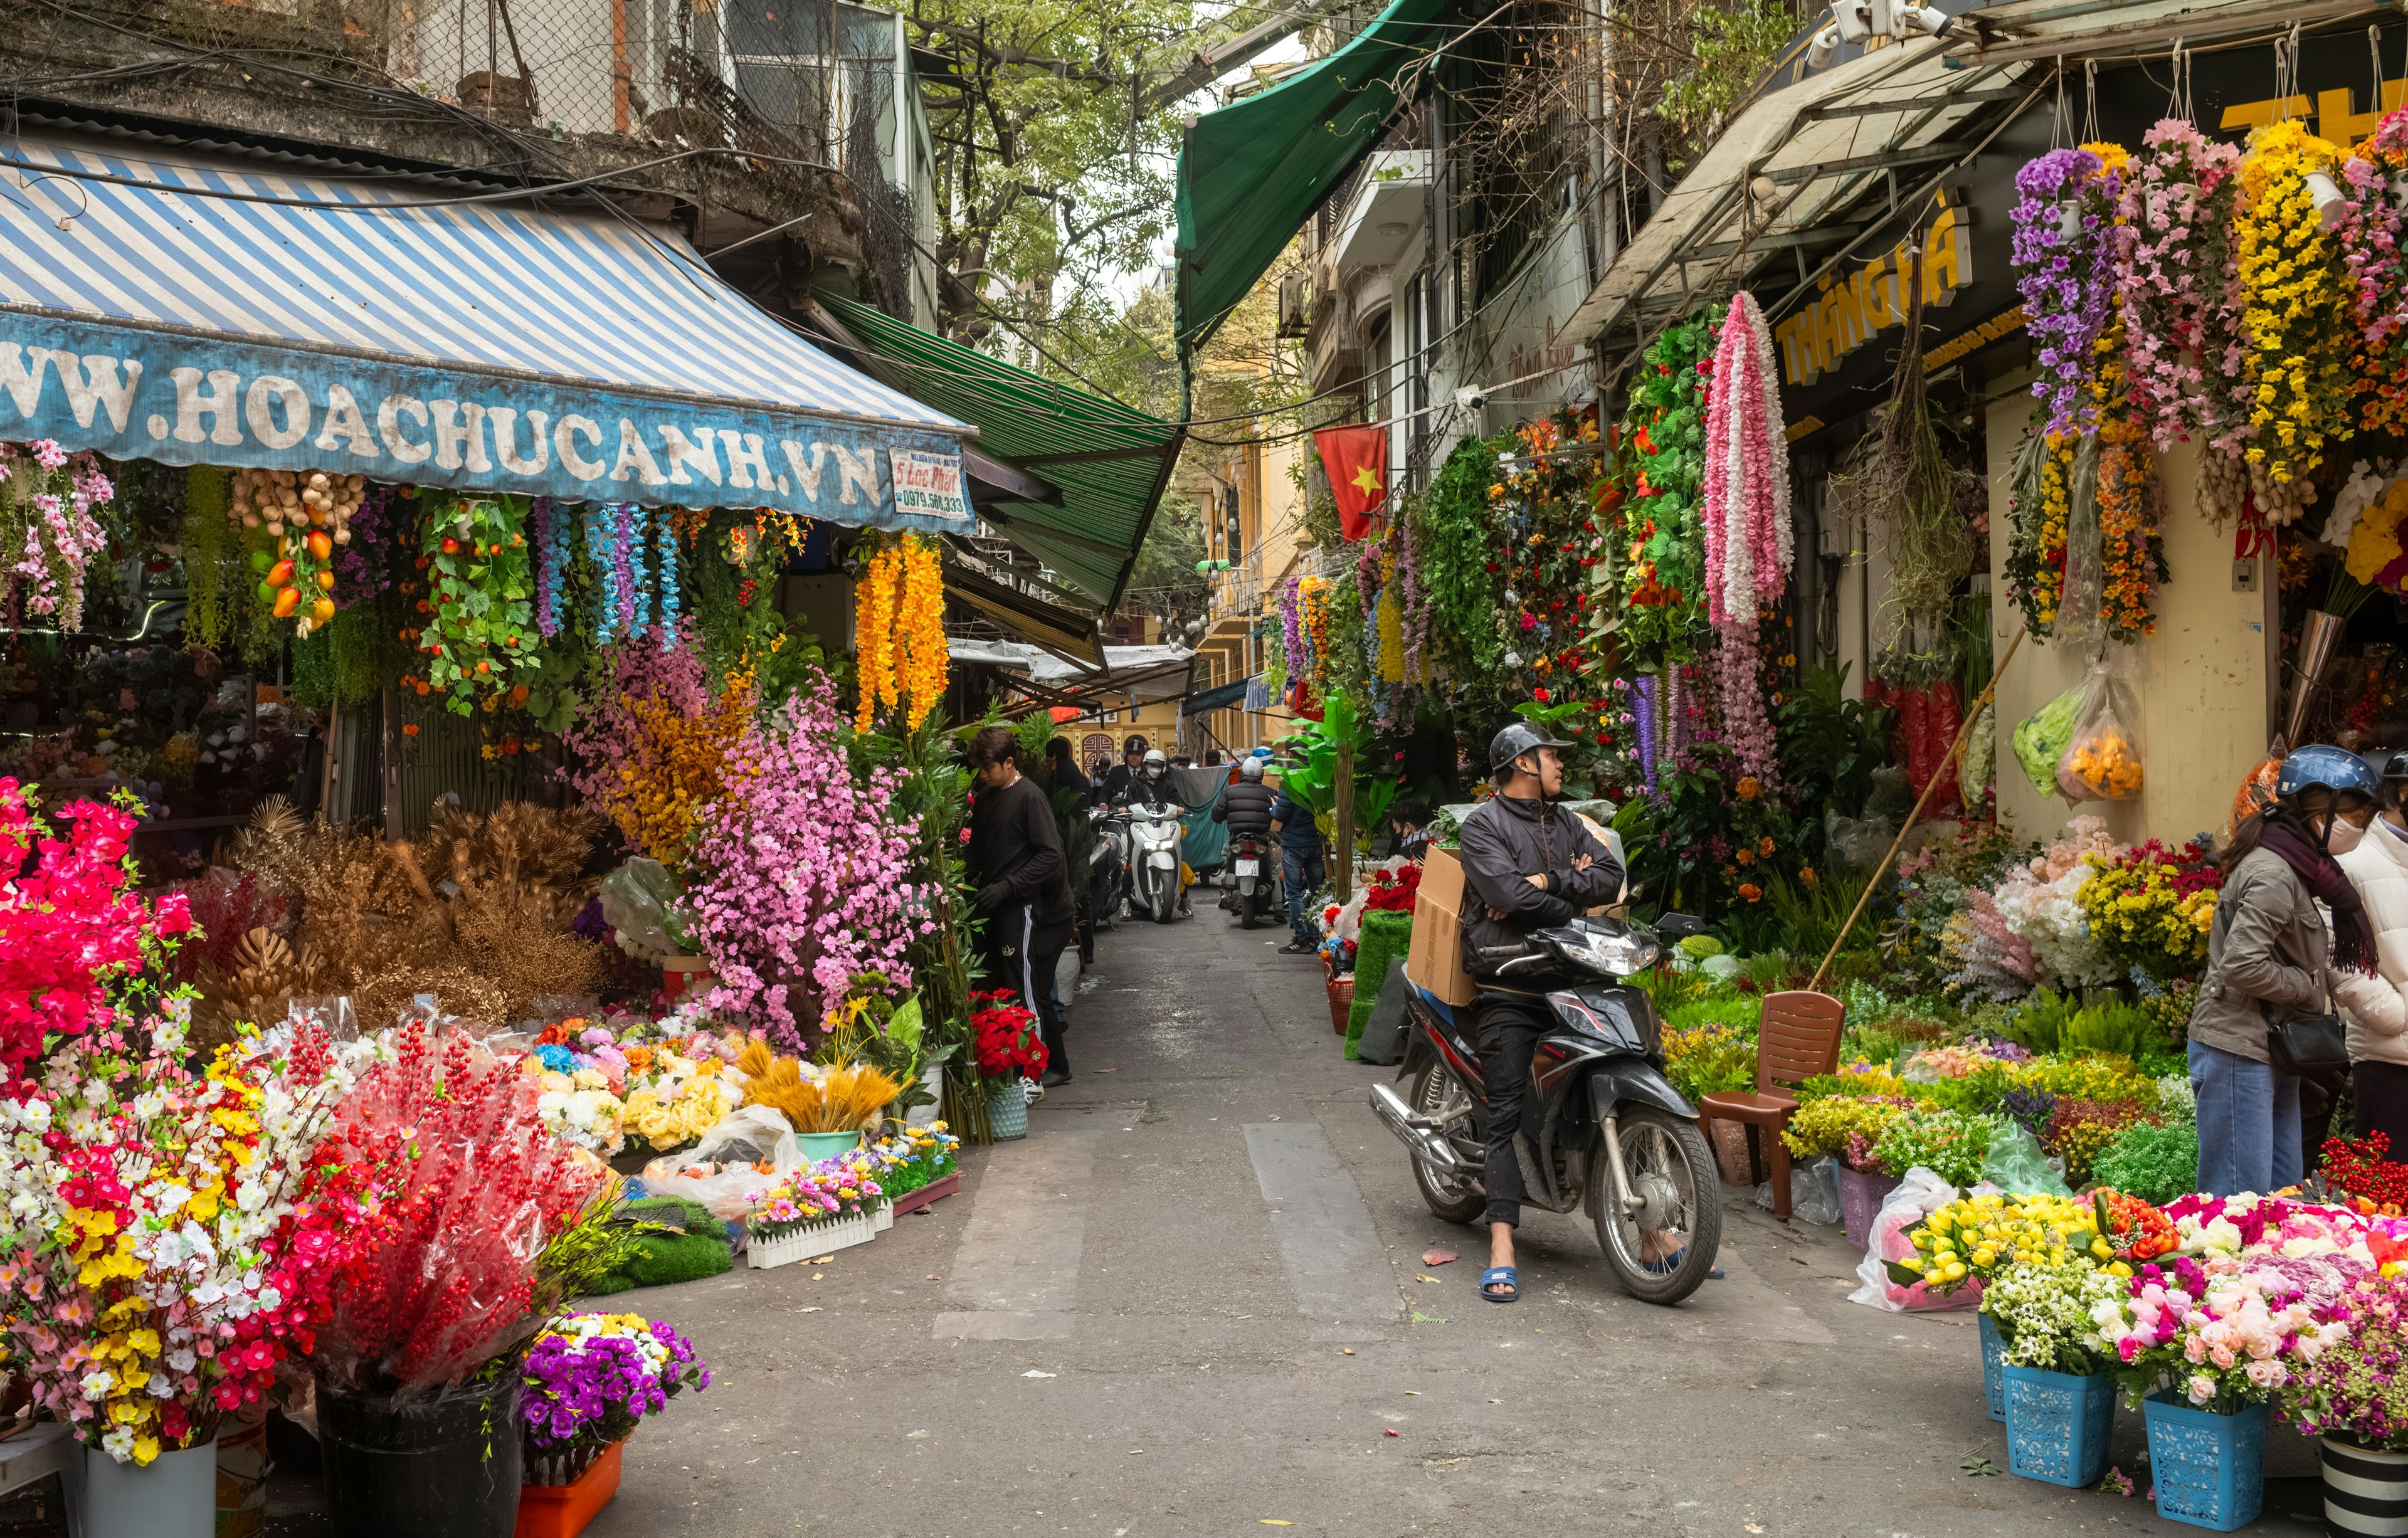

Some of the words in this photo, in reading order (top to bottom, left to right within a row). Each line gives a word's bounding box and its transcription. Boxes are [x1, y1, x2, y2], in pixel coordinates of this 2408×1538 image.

[895, 461, 905, 485] 5
[931, 466, 958, 493] Phát
[1544, 1044, 1565, 1060] HONDA
